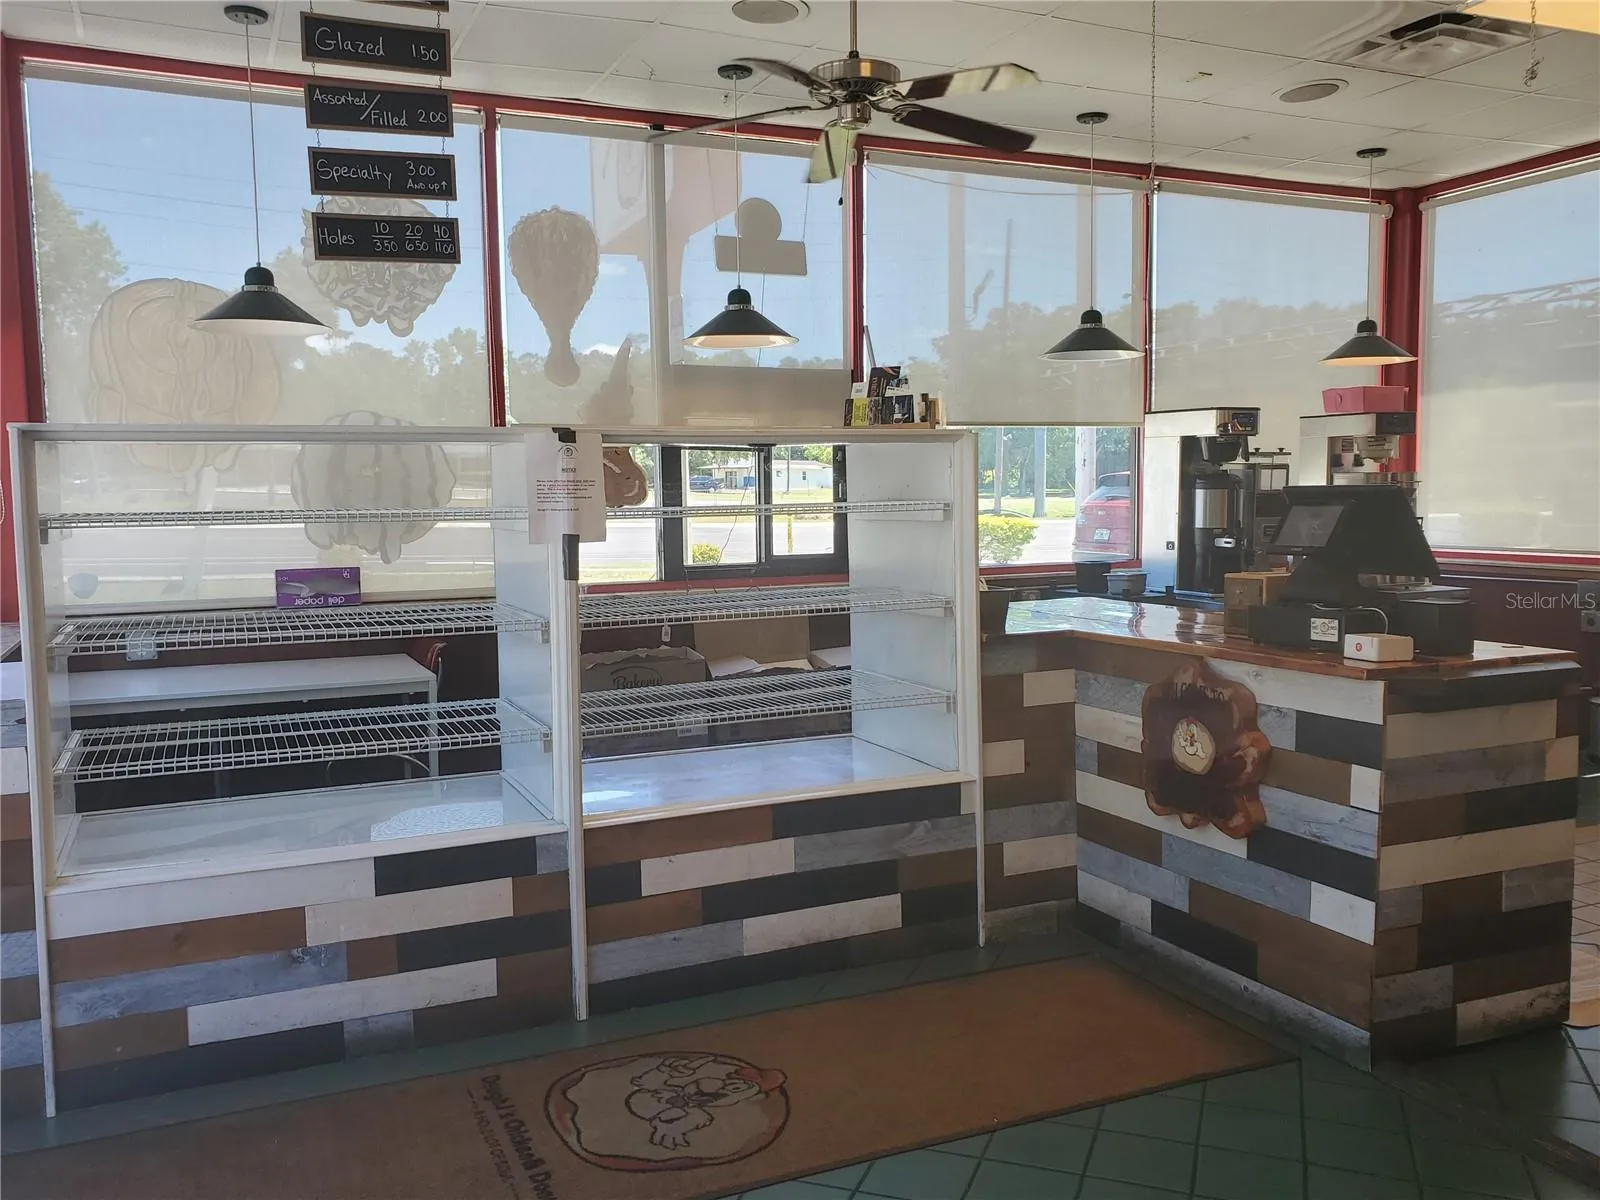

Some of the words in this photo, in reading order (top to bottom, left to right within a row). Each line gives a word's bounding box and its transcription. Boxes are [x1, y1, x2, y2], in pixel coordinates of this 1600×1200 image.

[315, 27, 385, 57] Glazed
[371, 109, 408, 127] Filled
[316, 158, 392, 190] Specialty
[318, 227, 356, 246] Holes
[374, 221, 390, 234] 10
[405, 223, 424, 236] 20
[433, 224, 450, 239] 40
[295, 596, 324, 606] paper
[328, 596, 345, 605] deli
